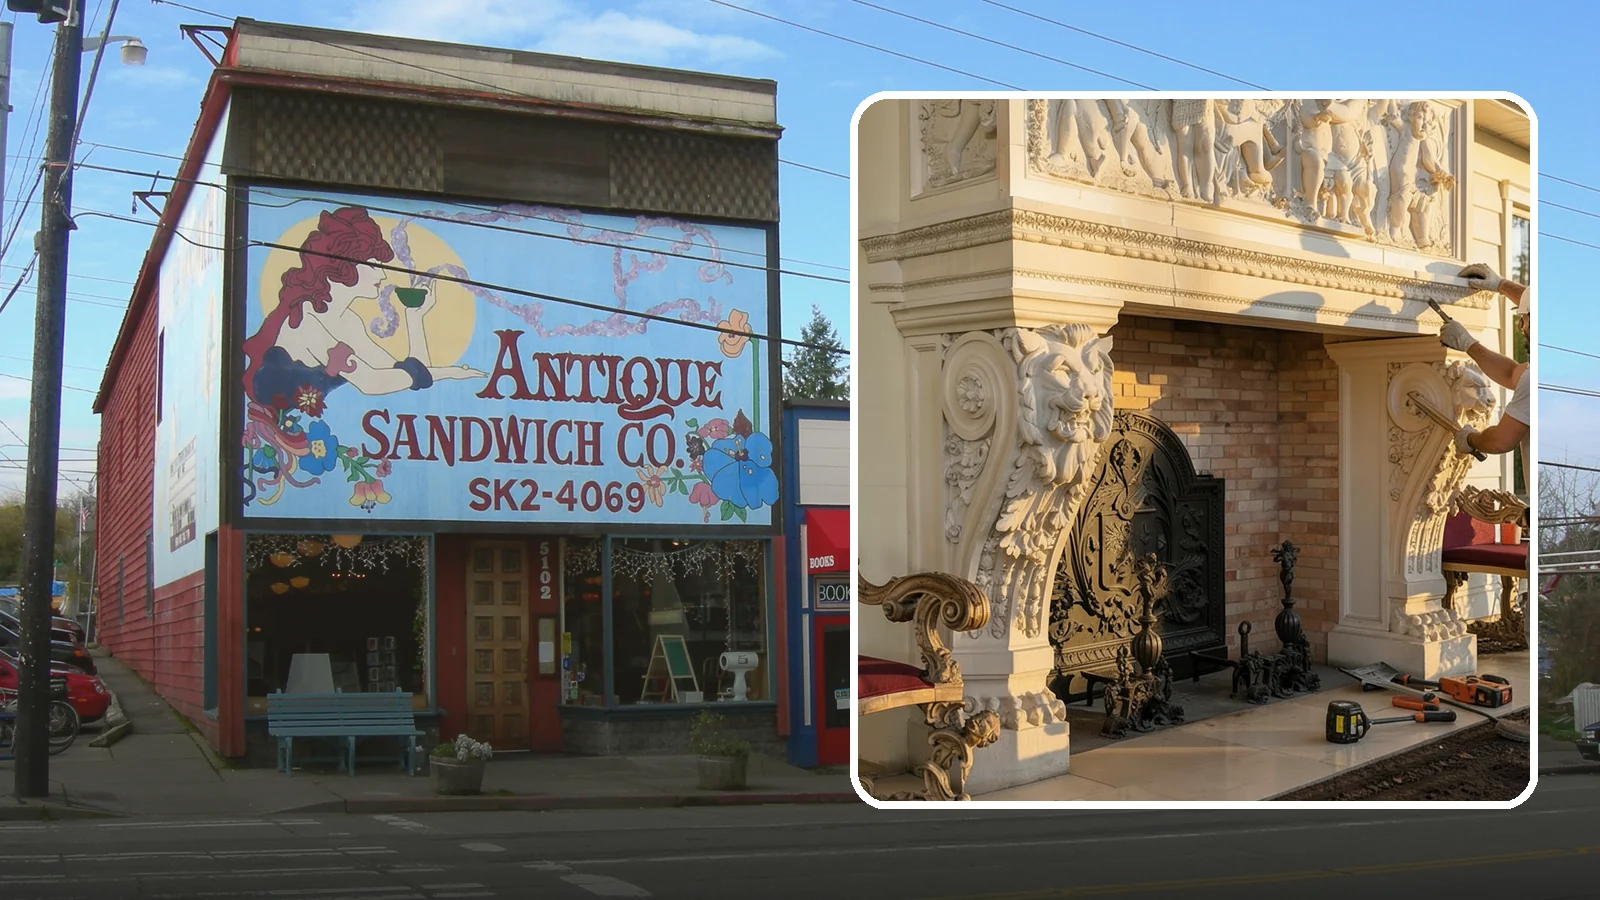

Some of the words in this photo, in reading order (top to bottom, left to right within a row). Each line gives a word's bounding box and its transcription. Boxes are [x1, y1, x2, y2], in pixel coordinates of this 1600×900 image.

[475, 329, 723, 421] ANTIQUE
[361, 409, 604, 466] SANDWICH
[617, 421, 685, 468] CO.
[468, 477, 646, 512] SK2-4069
[540, 541, 551, 600] 5102
[809, 555, 835, 569] BOOKS
